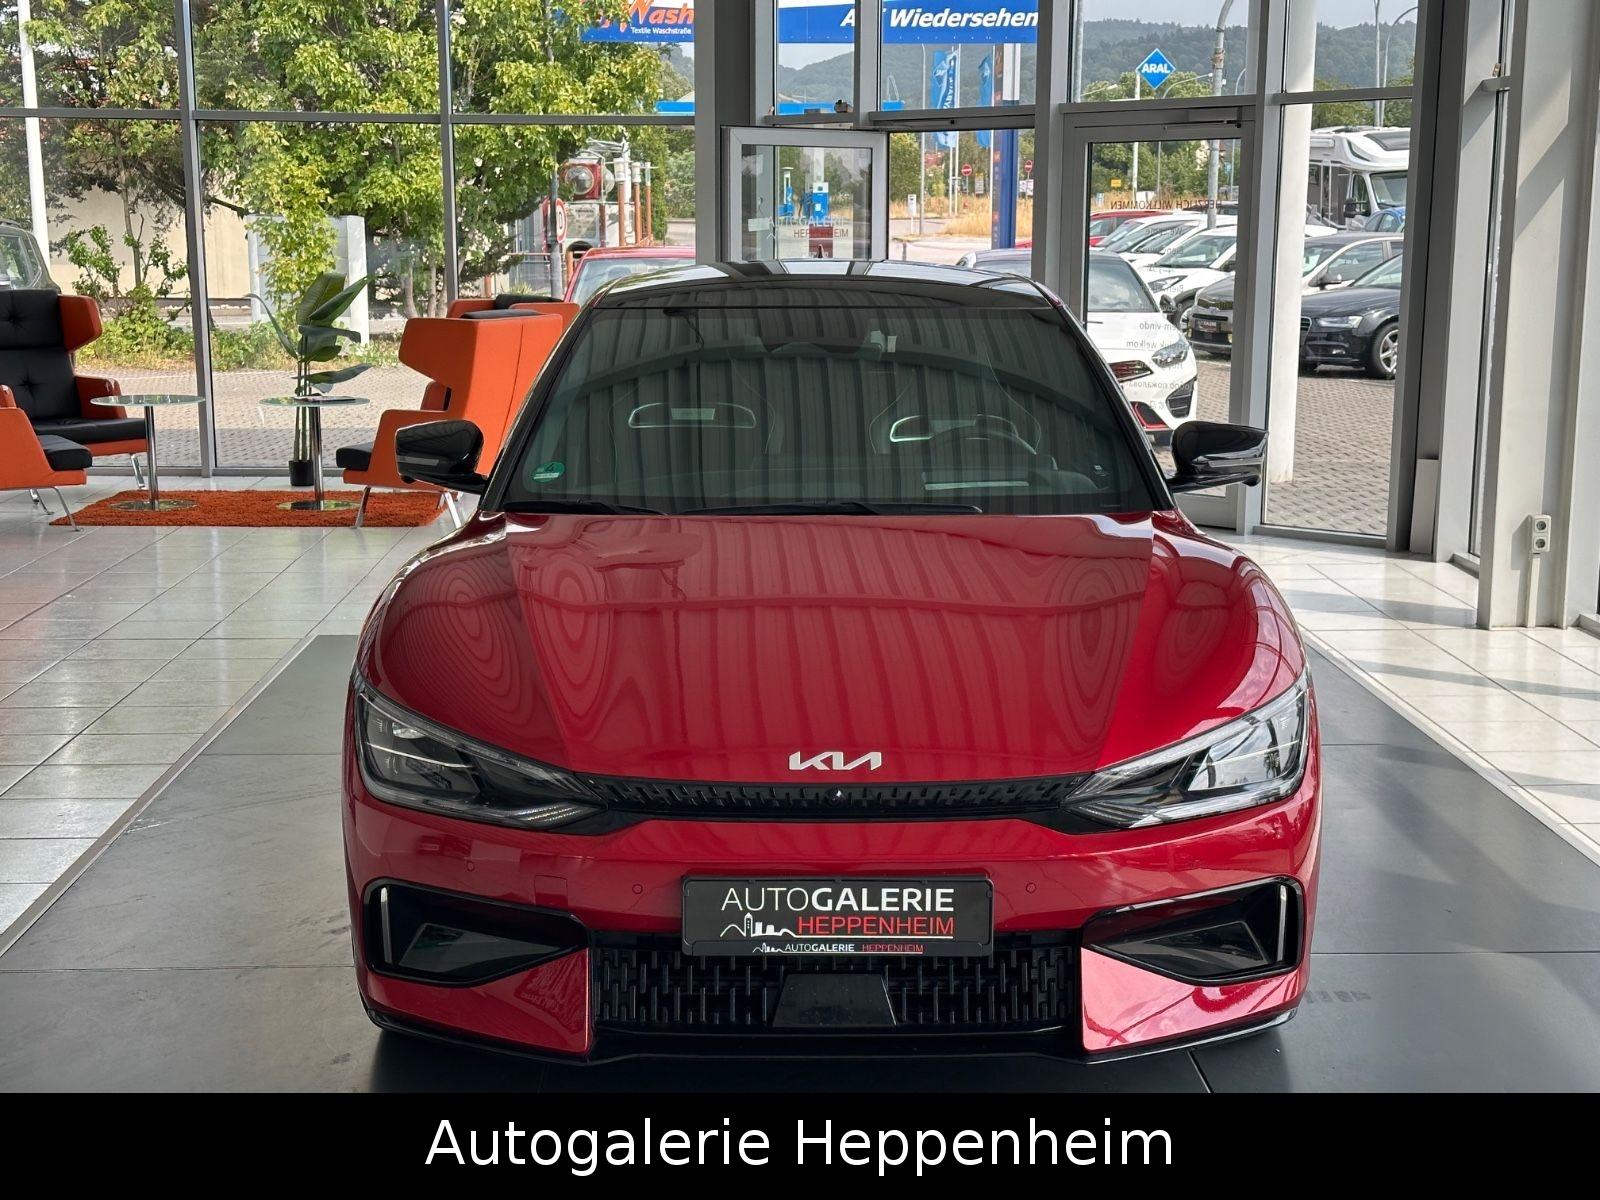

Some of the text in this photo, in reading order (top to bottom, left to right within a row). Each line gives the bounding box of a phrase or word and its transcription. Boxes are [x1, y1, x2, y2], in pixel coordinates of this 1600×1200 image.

[890, 8, 1038, 27] Wiedersehen
[653, 27, 692, 35] Waschstraße
[1141, 63, 1170, 74] ARAL
[768, 216, 848, 228] ATOGALERIE
[789, 751, 881, 771] KIA
[721, 887, 954, 912] AUTOGALERIE
[798, 916, 954, 935] HEPPENHEIM
[785, 943, 923, 952] AUTOGALERIE HEPPENHEIM
